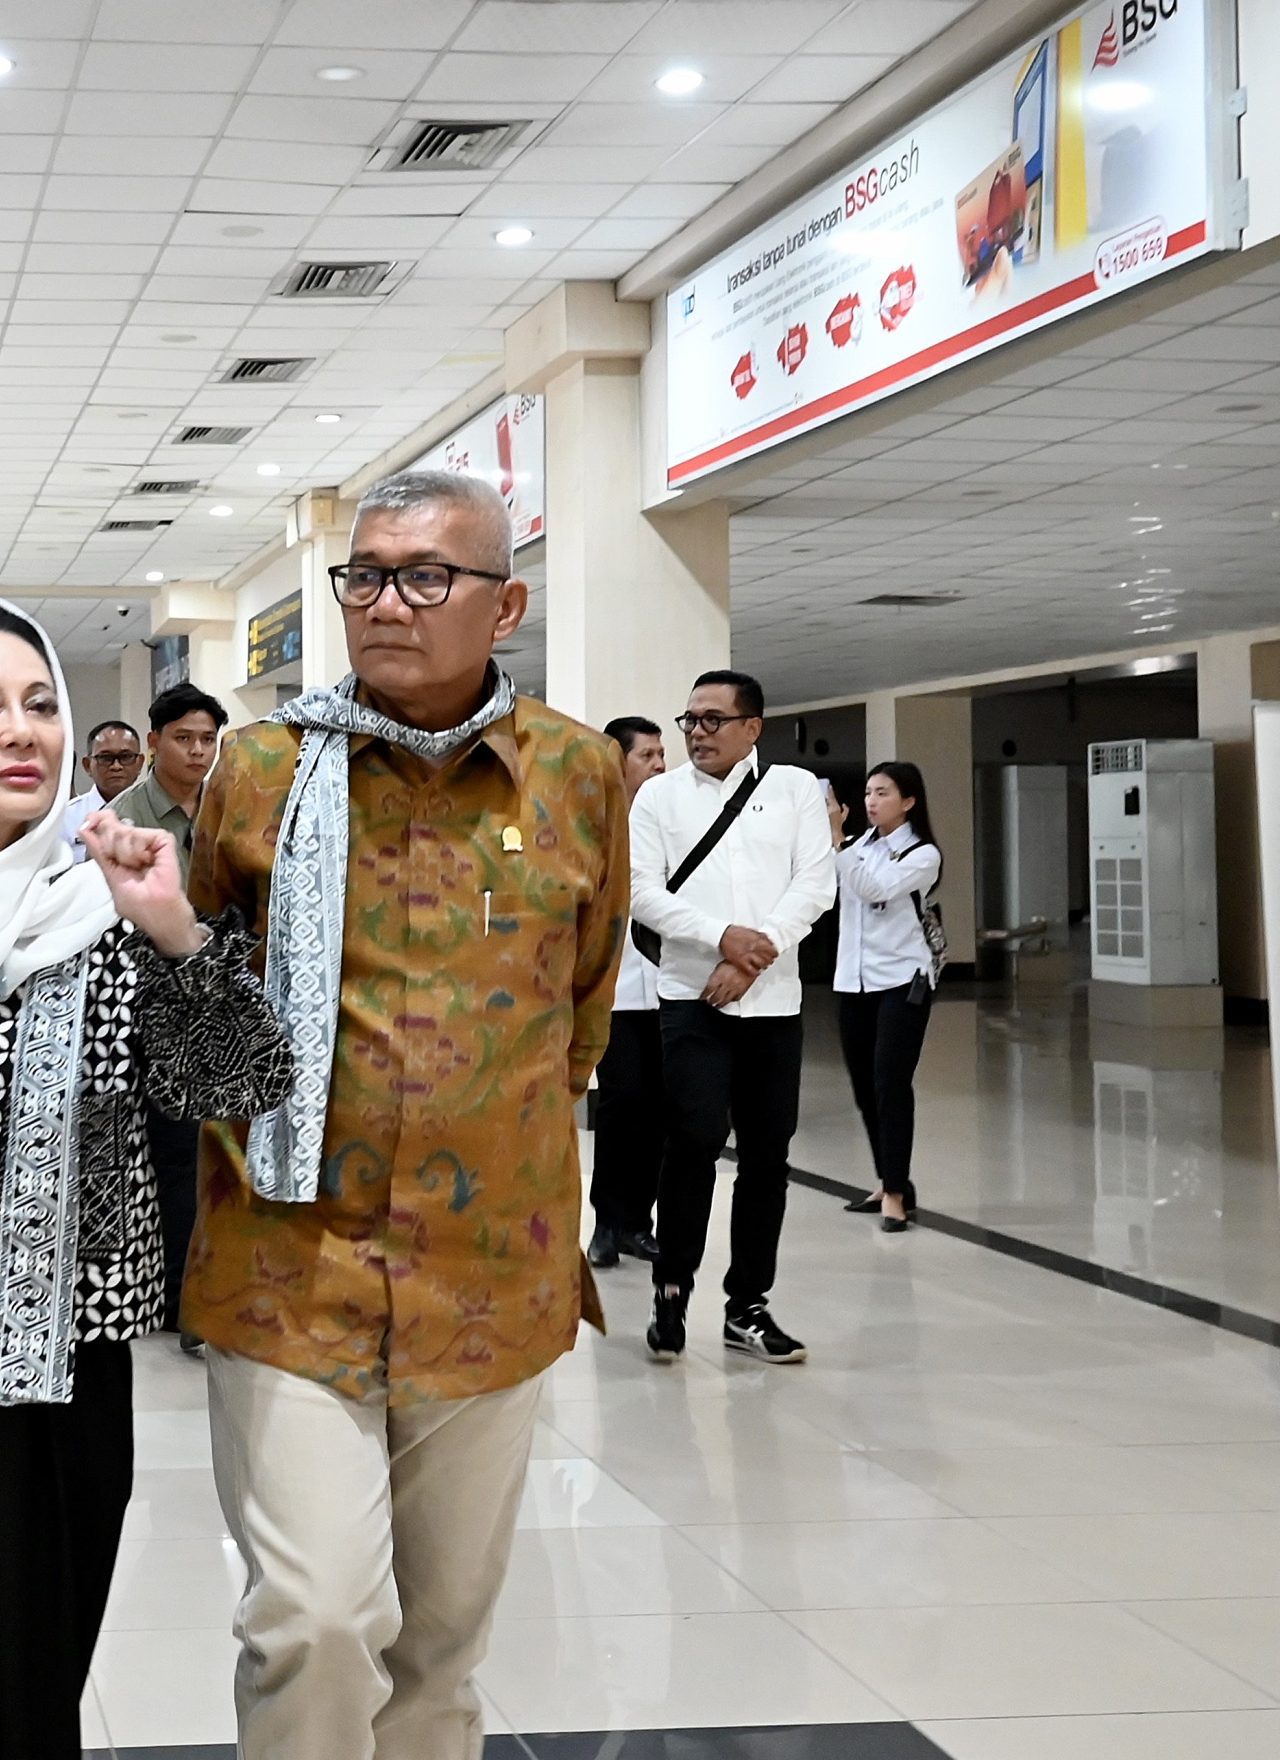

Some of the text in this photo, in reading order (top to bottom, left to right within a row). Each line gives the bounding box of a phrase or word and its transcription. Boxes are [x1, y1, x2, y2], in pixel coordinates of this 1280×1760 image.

[726, 254, 762, 294] transaksi
[762, 242, 786, 270] tanpa
[786, 224, 807, 257] tunai
[807, 206, 843, 242] dengan
[844, 138, 920, 220] BSGcash
[1113, 237, 1163, 275] 1500 659
